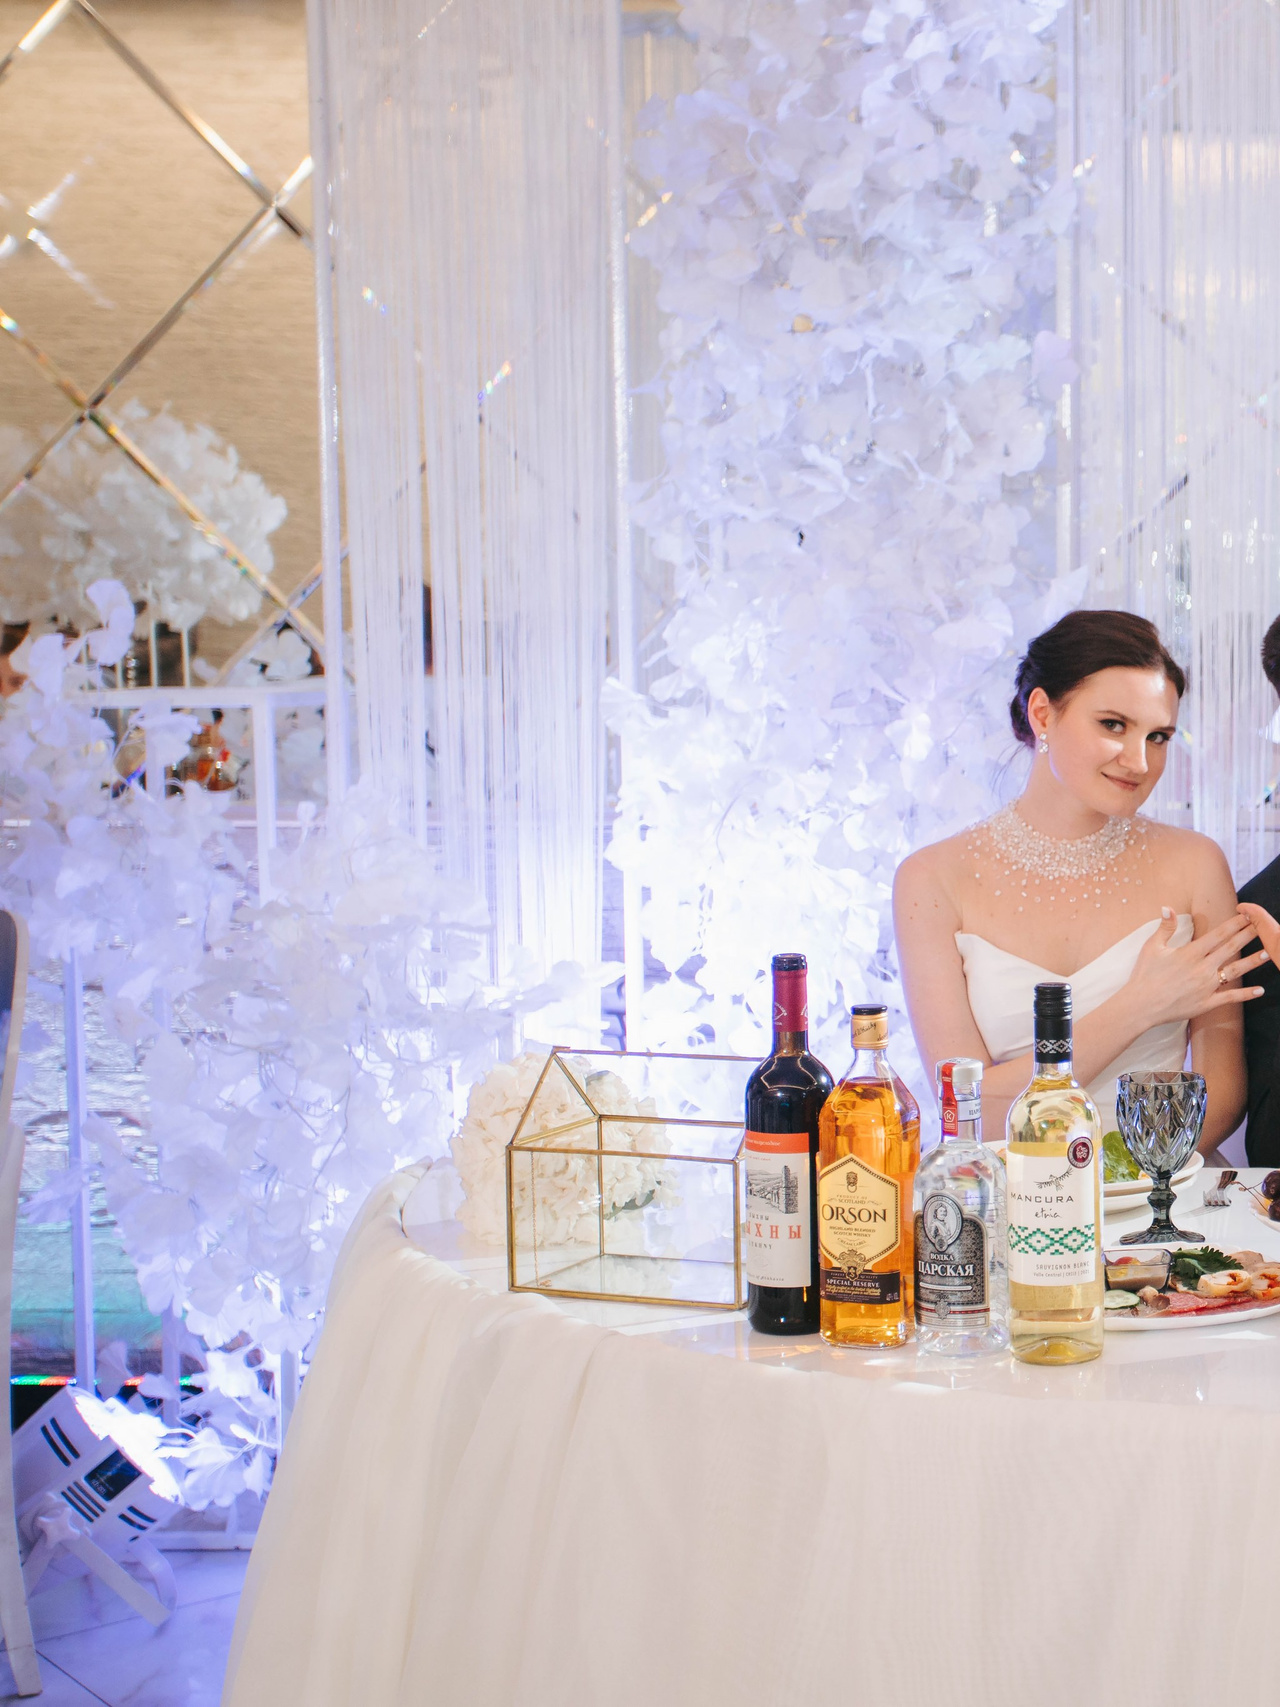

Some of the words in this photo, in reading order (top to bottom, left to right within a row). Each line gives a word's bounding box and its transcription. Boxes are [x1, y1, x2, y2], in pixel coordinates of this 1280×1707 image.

[1010, 1192, 1075, 1204] MANCURA
[821, 1203, 887, 1225] ORSON
[1035, 1207, 1062, 1218] etnia
[930, 1253, 954, 1261] ВОДКА
[918, 1260, 975, 1277] ЦАРСКАЯ
[1073, 1261, 1090, 1269] BLANC
[826, 1278, 851, 1286] SPECIAL
